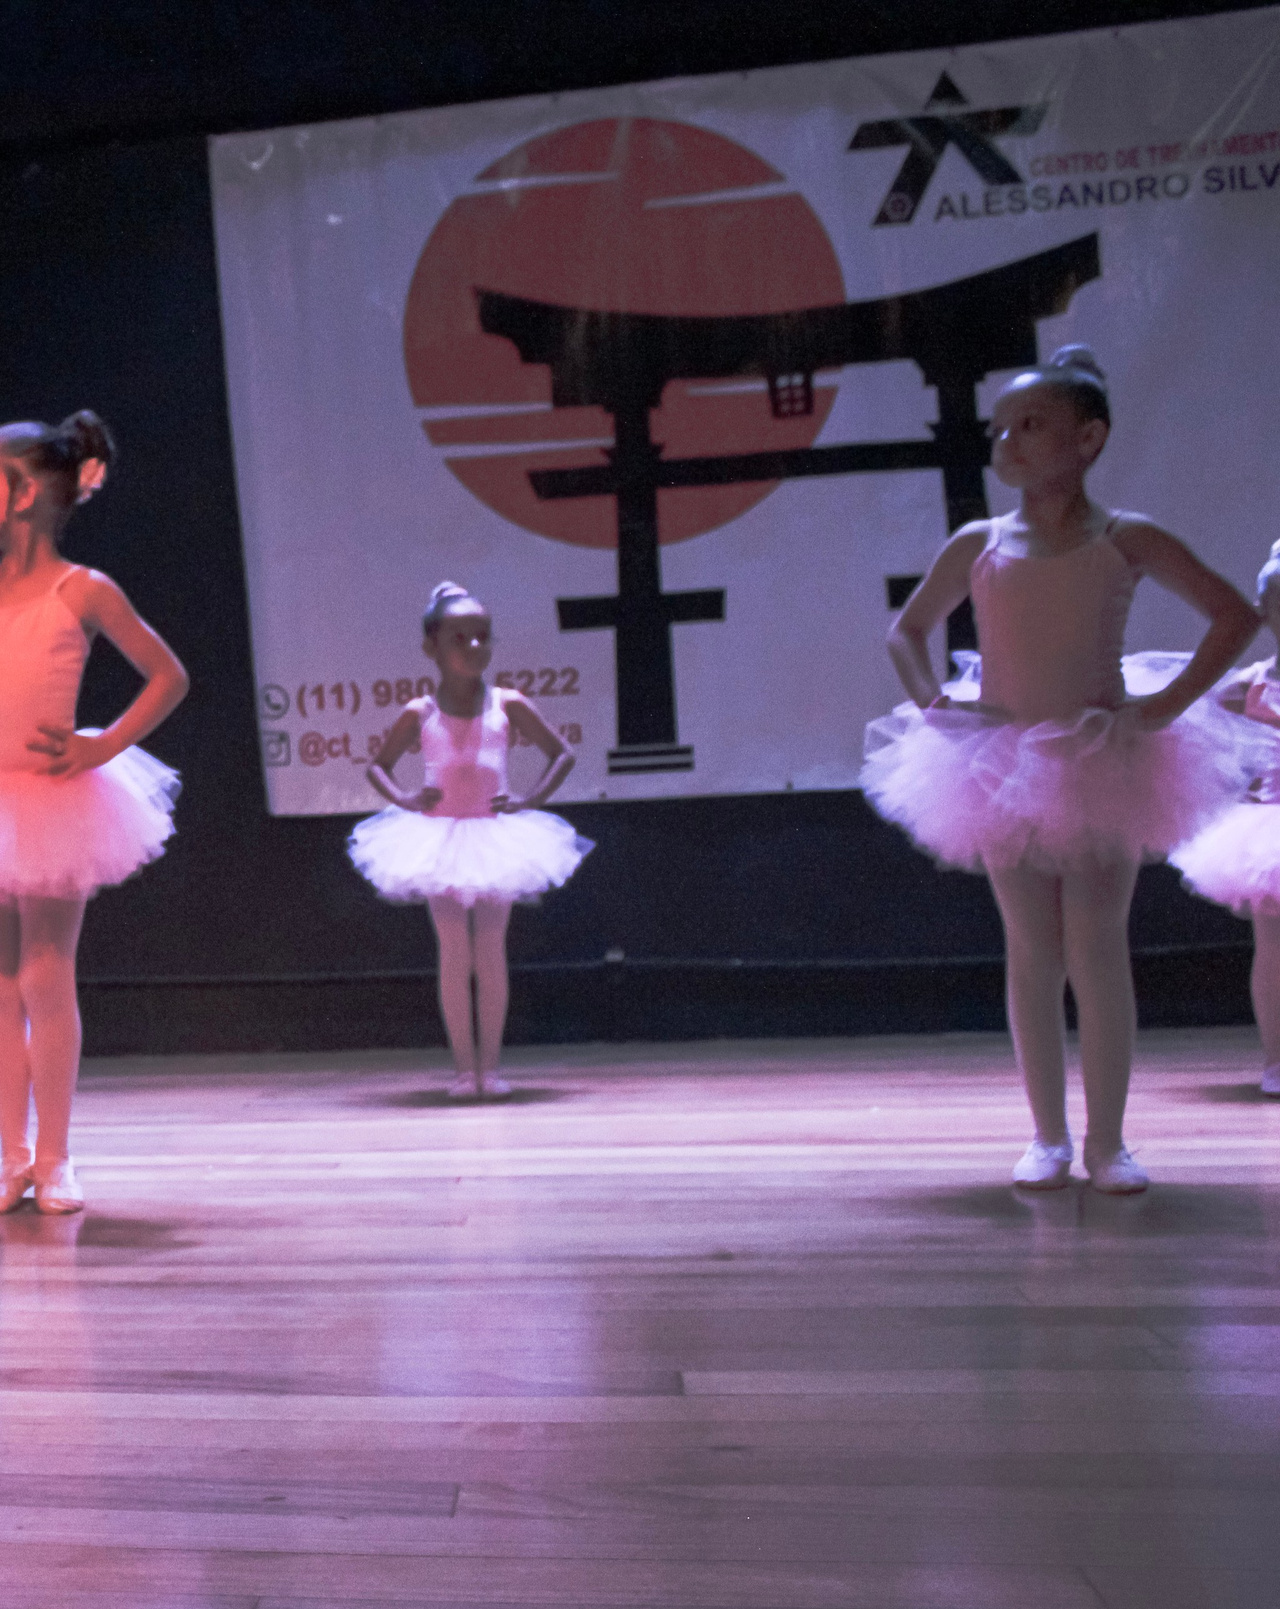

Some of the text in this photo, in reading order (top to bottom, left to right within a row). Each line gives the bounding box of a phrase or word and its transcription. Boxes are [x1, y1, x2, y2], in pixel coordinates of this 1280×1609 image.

[1029, 151, 1108, 177] CENTRO
[1116, 147, 1140, 169] DE
[934, 172, 1190, 221] ALESSANDRO
[296, 681, 362, 718] (11)
